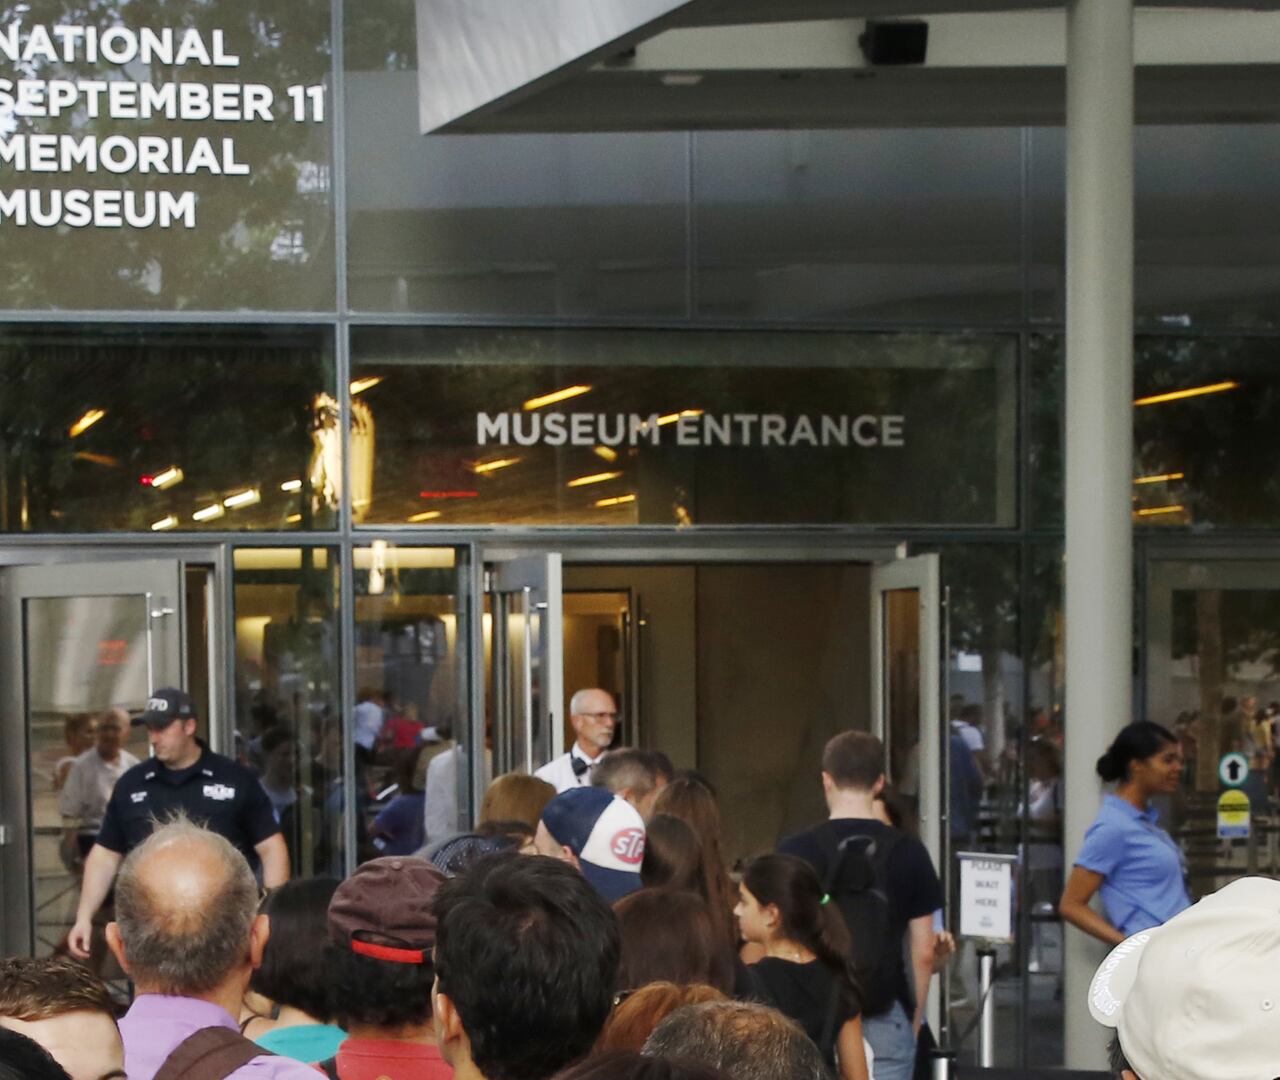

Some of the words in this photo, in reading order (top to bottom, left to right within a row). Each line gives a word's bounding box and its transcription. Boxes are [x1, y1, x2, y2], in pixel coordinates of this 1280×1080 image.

[287, 84, 325, 122] 11
[476, 412, 660, 446] MUSEUM
[677, 413, 906, 447] ENTRANCE
